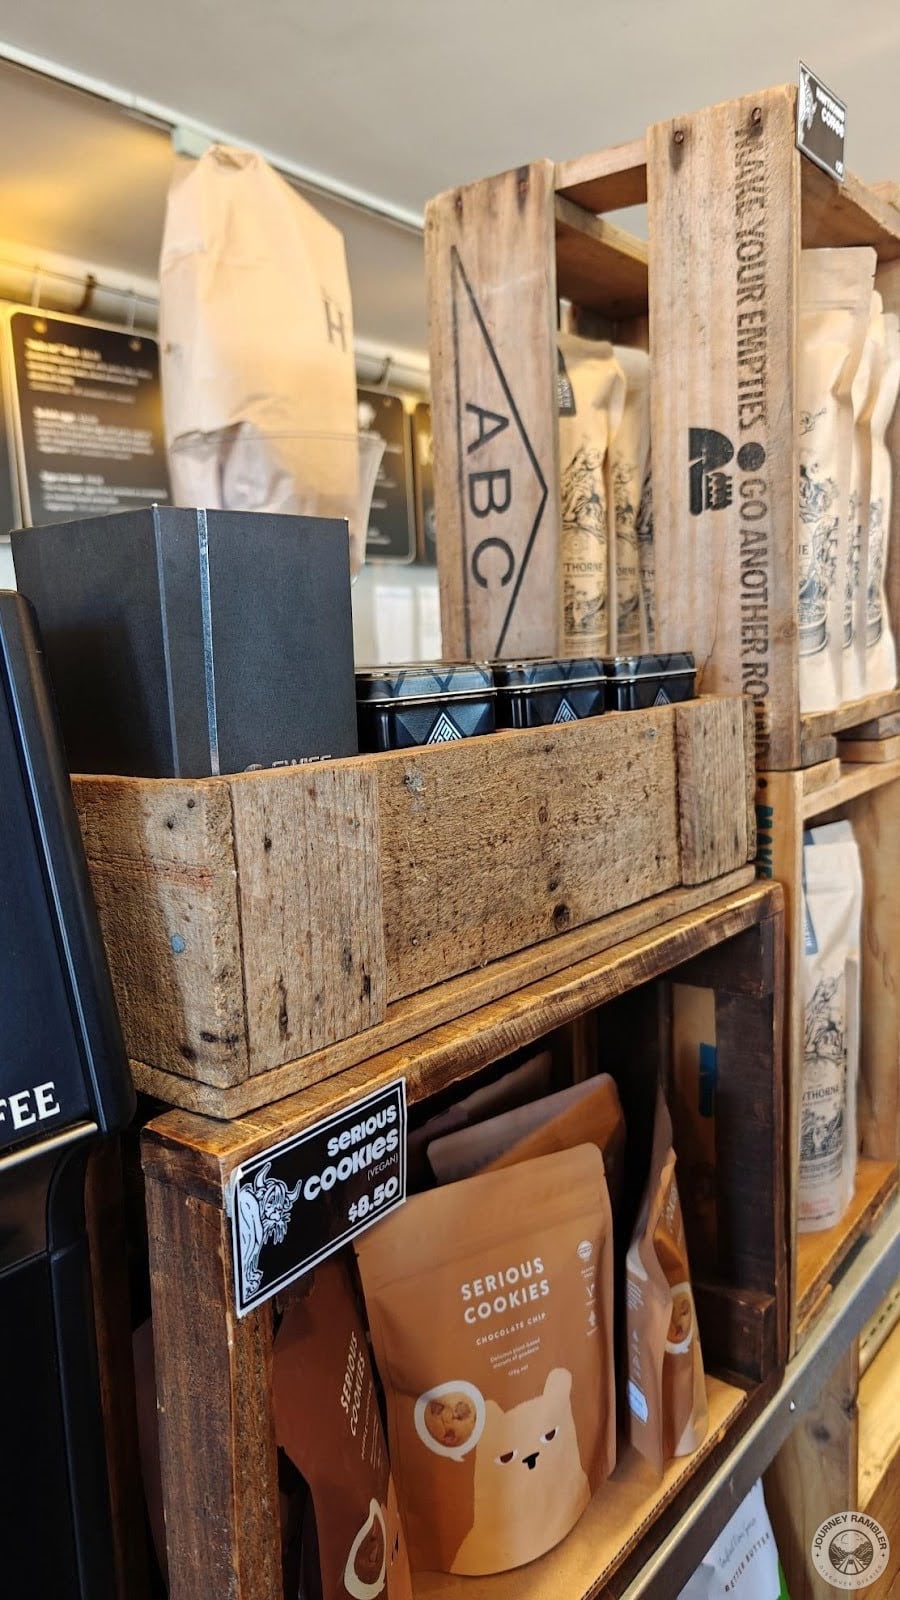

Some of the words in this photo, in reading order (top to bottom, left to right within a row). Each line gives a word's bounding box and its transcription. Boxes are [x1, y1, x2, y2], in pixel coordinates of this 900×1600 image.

[734, 128, 766, 217] MAKE
[735, 217, 767, 307] YOUR
[736, 309, 769, 432] EMPTIES
[464, 402, 515, 589] ABC
[738, 478, 768, 522] GO
[738, 528, 769, 658] ANOTHER
[347, 1175, 399, 1224] $8.50
[367, 1152, 399, 1181] (VEGAN)
[461, 1256, 545, 1301] SERIOUS
[463, 1279, 550, 1325] COOKIES
[475, 1320, 525, 1347] CHOCOLATE
[526, 1311, 547, 1326] CHIP
[340, 1331, 358, 1414] SERIOUS
[349, 1351, 366, 1437] COOKIES
